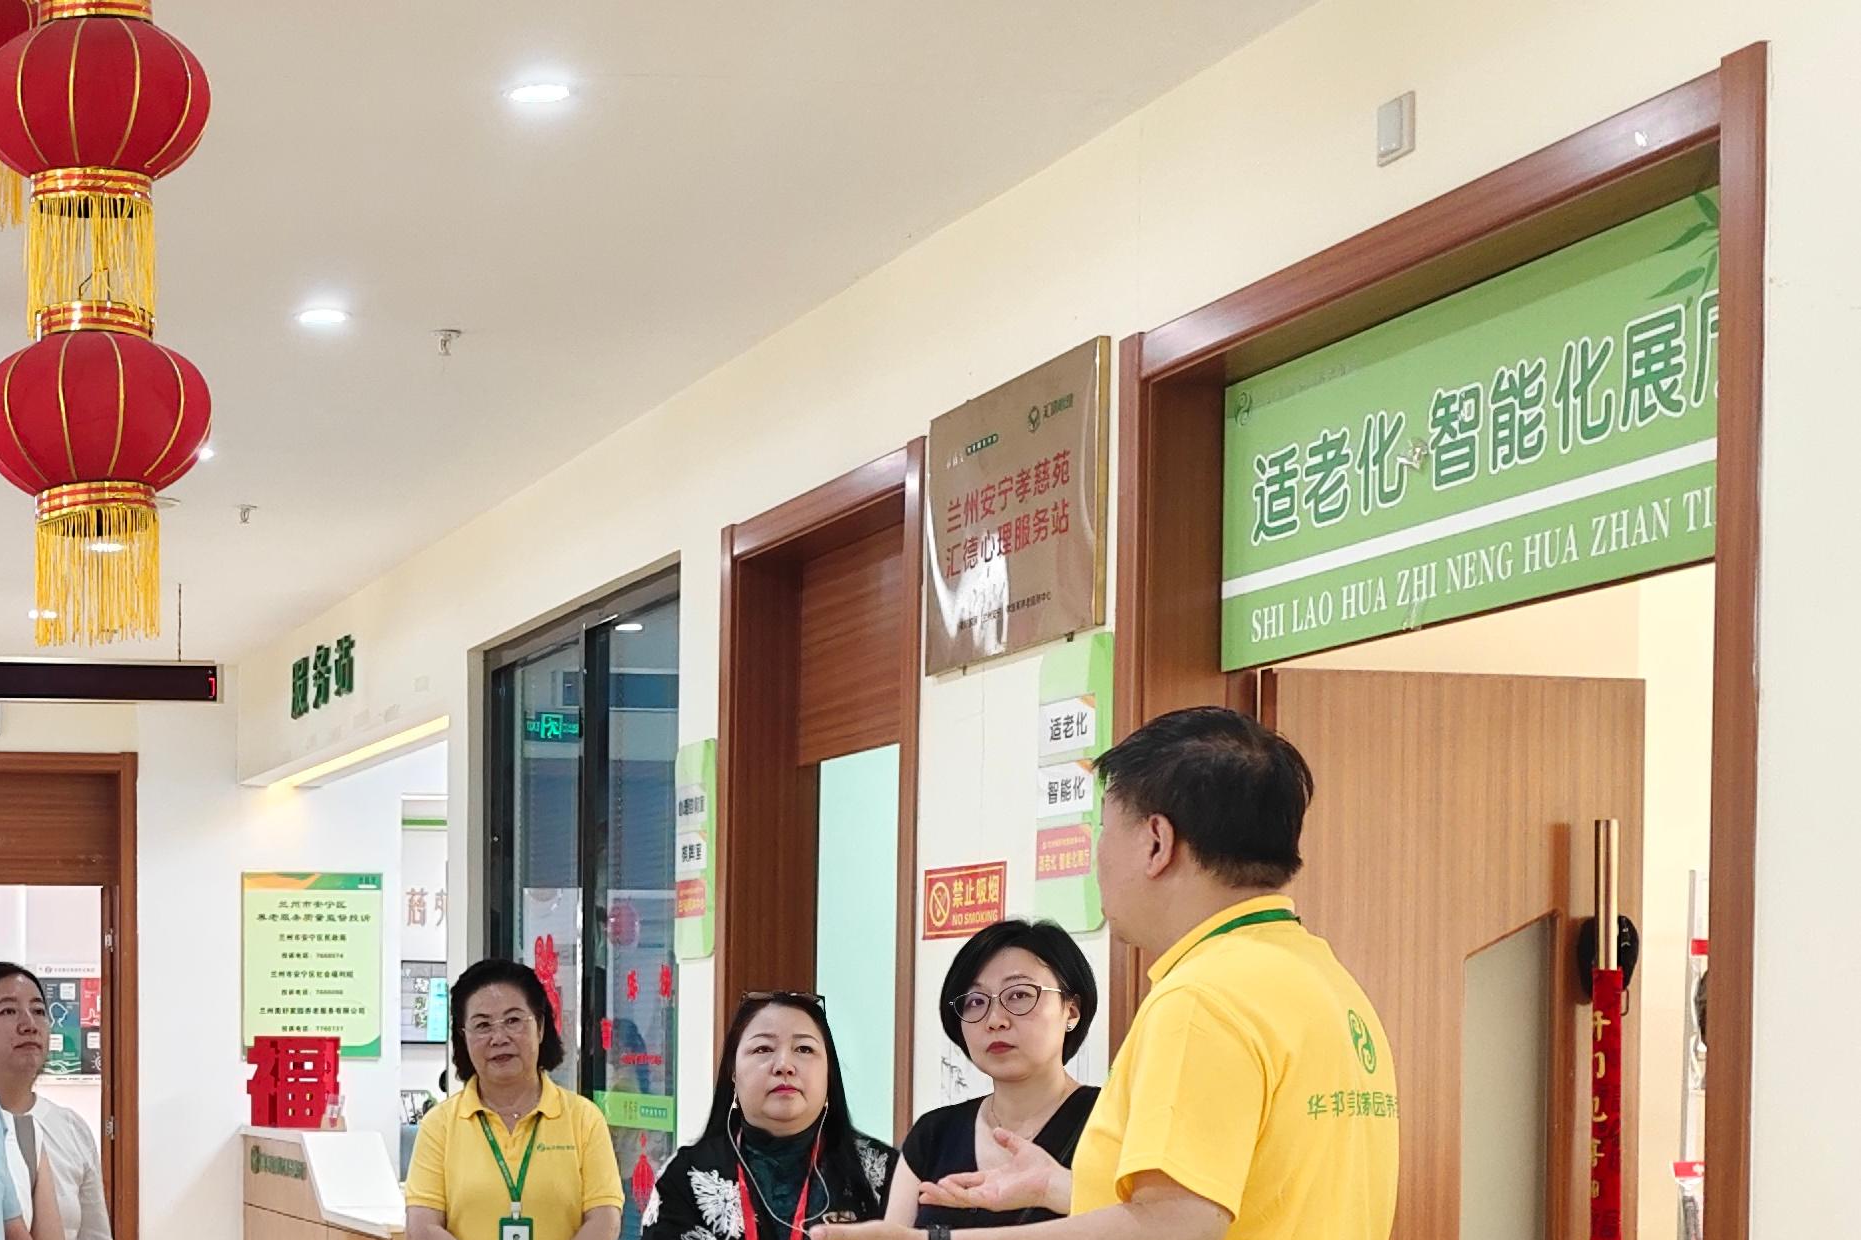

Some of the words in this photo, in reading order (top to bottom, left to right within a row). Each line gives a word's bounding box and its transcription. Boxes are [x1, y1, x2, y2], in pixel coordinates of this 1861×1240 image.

[946, 449, 1071, 534] 兰州安宁孝慈苑
[1251, 411, 1405, 547] 适老化
[945, 500, 1070, 580] 汇德心理服务站
[1251, 604, 1285, 643] SHI
[1292, 590, 1332, 634] LAO
[1341, 575, 1387, 621] HUA
[1396, 561, 1437, 607] ZHI
[1446, 541, 1513, 596] NENG
[1524, 523, 1579, 575] HUA
[1590, 498, 1672, 558] ZHAN
[1682, 484, 1716, 533] TI
[1050, 711, 1088, 742] 适老化
[1047, 776, 1085, 805] 智能化
[952, 875, 1000, 908] 禁止吸烟
[952, 914, 963, 926] NO
[964, 909, 998, 924] SMOKING
